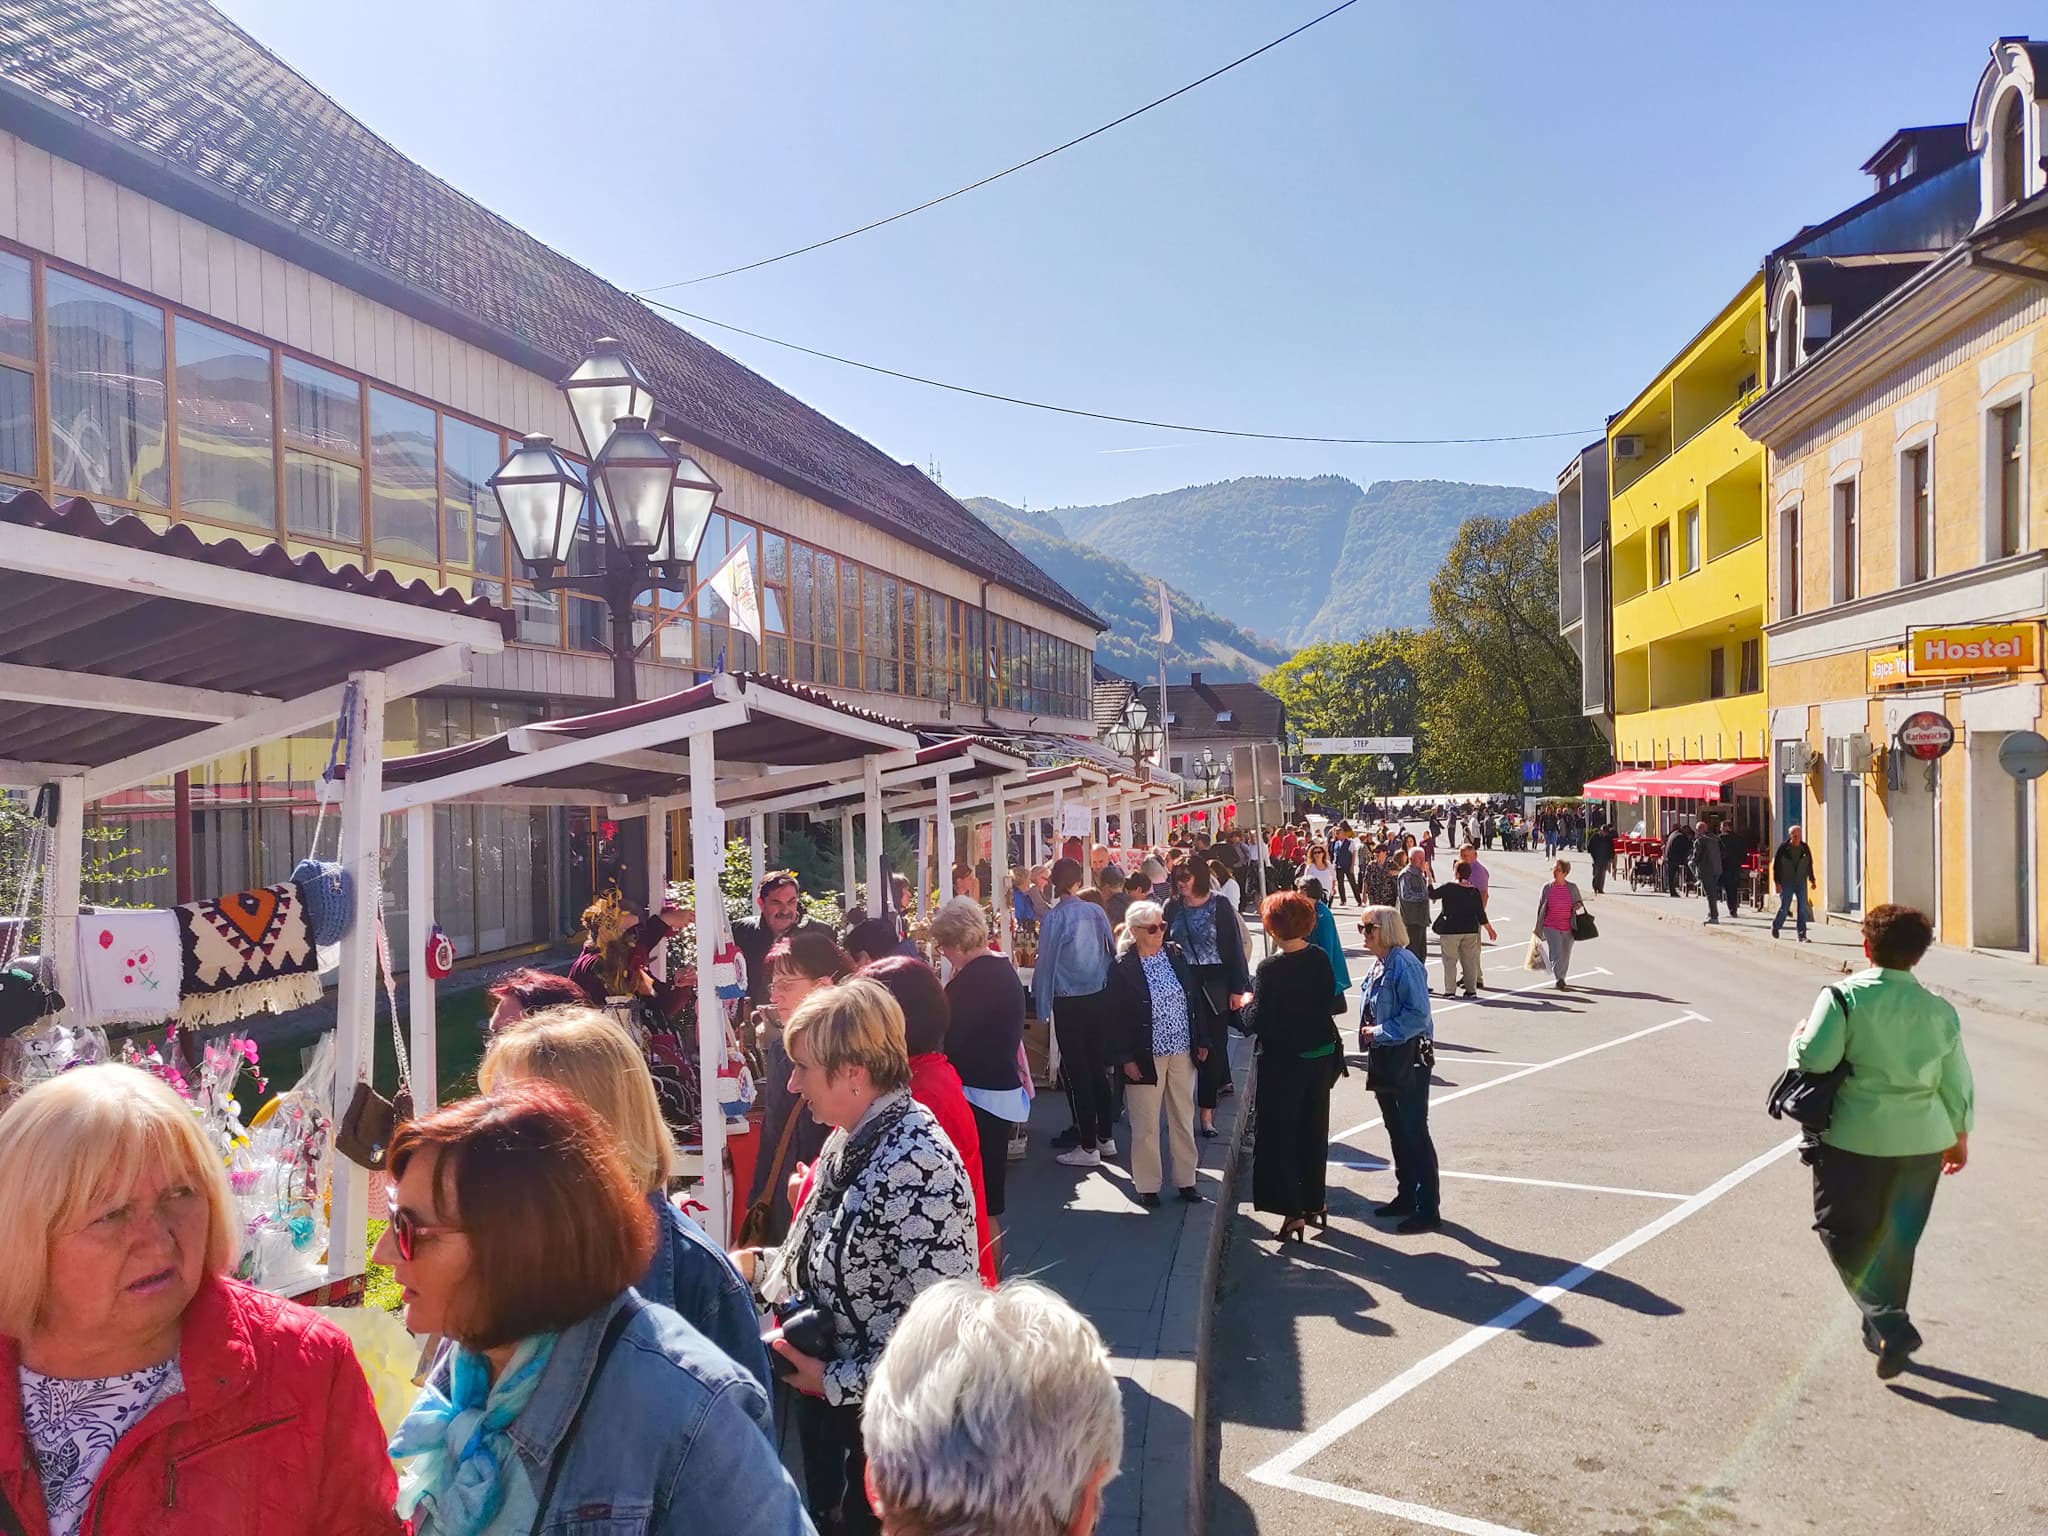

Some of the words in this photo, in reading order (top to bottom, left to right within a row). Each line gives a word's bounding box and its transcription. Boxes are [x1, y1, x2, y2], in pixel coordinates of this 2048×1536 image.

[1925, 637, 2021, 661] Hostel
[1872, 661, 1895, 680] Jajce
[1353, 739, 1369, 748] STEP
[713, 834, 720, 856] 3
